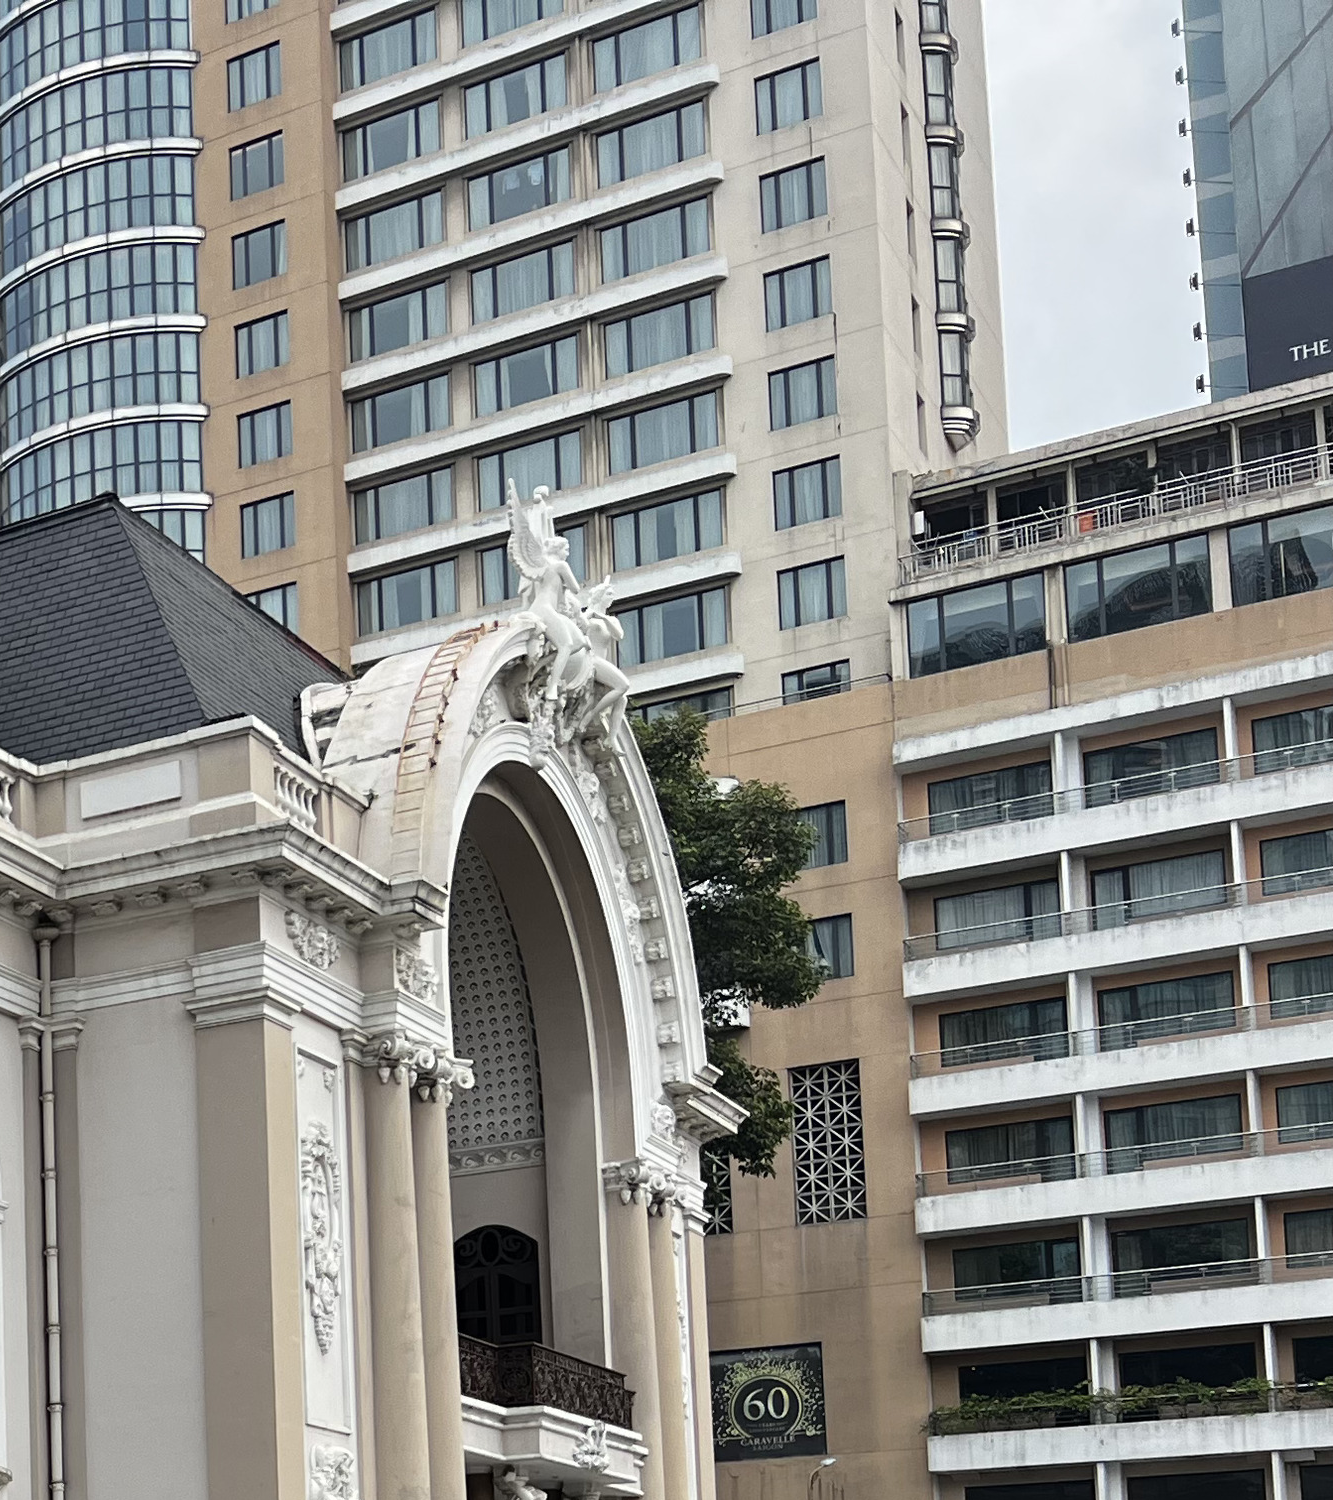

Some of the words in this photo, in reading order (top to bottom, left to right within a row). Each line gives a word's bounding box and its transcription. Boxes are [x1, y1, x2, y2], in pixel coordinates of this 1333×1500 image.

[1289, 339, 1332, 362] THE
[743, 1386, 790, 1421] 60
[740, 1435, 796, 1447] CARAVELLE
